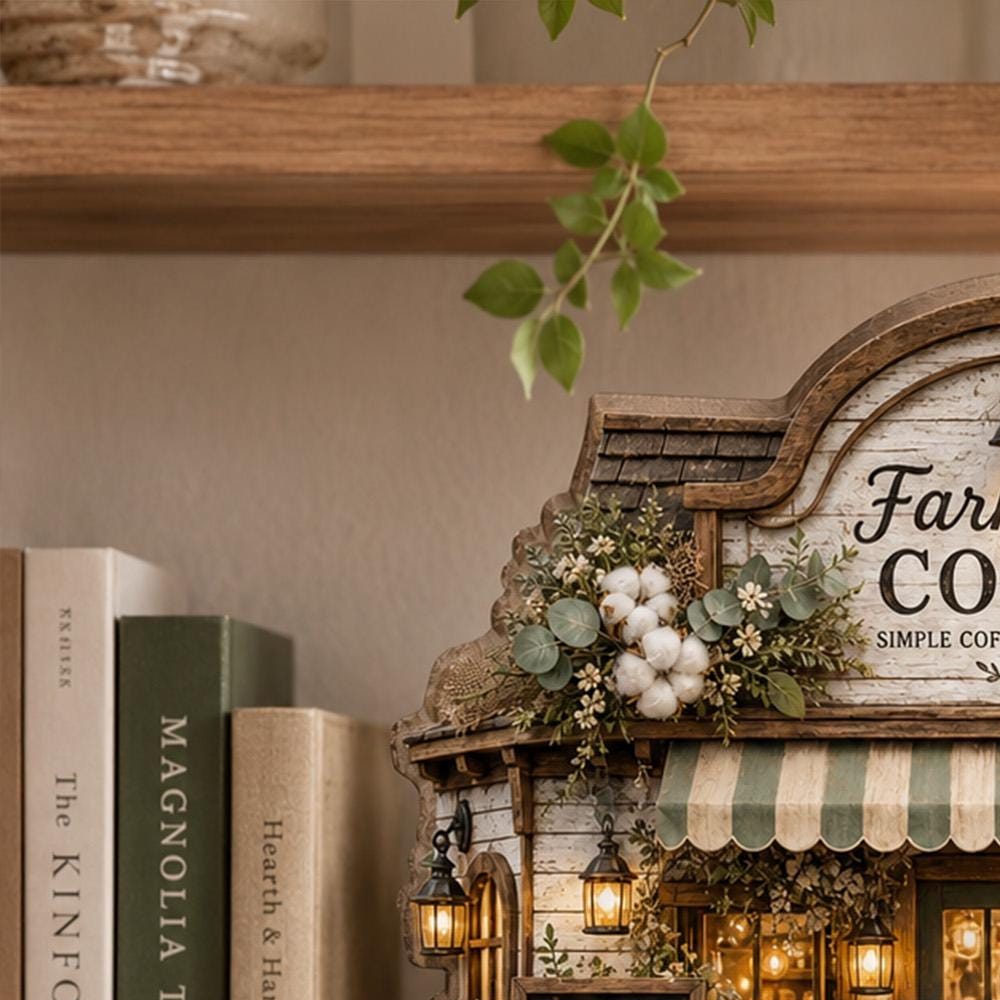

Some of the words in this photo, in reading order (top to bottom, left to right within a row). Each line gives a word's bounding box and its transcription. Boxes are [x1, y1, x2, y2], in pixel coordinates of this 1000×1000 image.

[876, 630, 952, 649] SIMPLE
[54, 772, 78, 828] The
[159, 715, 188, 961] MAGNOLIA
[261, 819, 284, 916] Hearth
[261, 926, 283, 945] &
